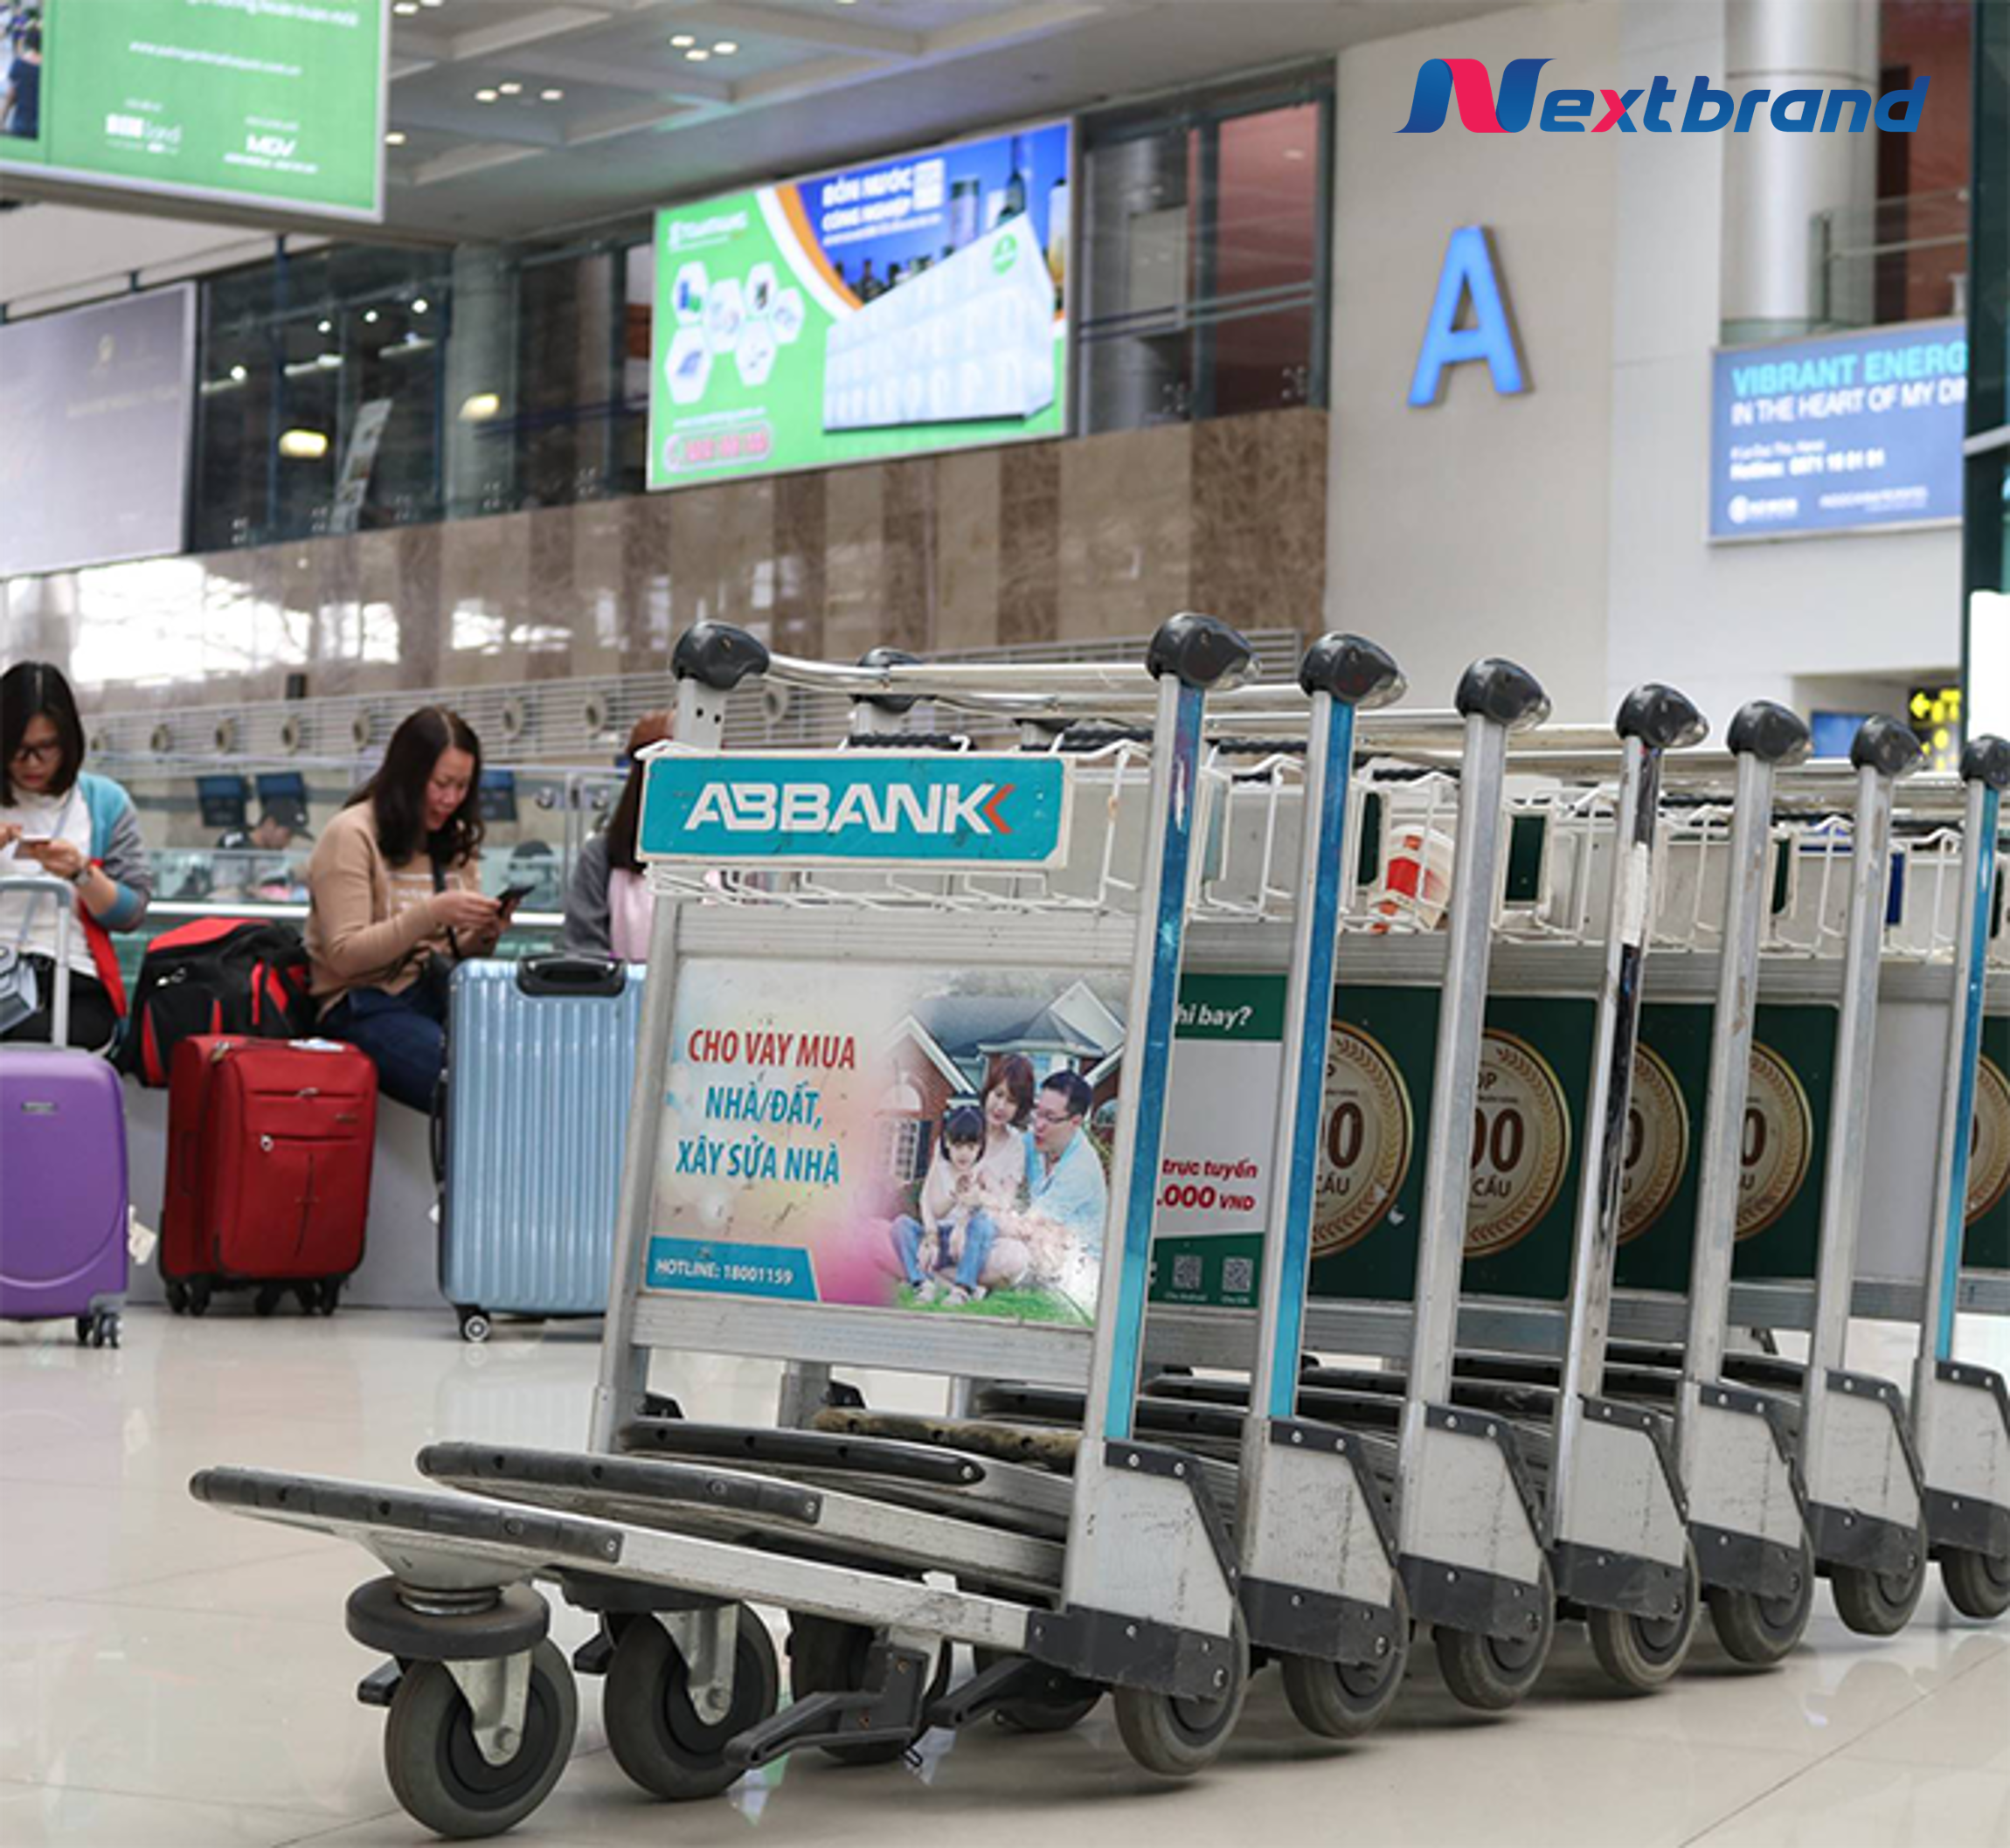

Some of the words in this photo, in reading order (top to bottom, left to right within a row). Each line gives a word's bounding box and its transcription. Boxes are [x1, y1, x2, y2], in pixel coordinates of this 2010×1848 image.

[1408, 225, 1528, 407] A
[1731, 353, 1858, 398] VIBRANT
[1730, 402, 1753, 426] IN
[1757, 396, 1795, 422] THE
[1799, 387, 1865, 419] HEART
[1868, 384, 1896, 412] OF
[1901, 381, 1936, 407] MY
[683, 782, 1015, 834] ABBANK
[1197, 1003, 1253, 1030] bay?
[687, 1028, 738, 1063] CHO
[795, 1035, 855, 1069] MUA
[676, 1135, 724, 1176] XÂY
[727, 1133, 778, 1180] SỬA
[784, 1141, 841, 1185] NHÀ
[655, 1258, 721, 1278] HOTLINE:
